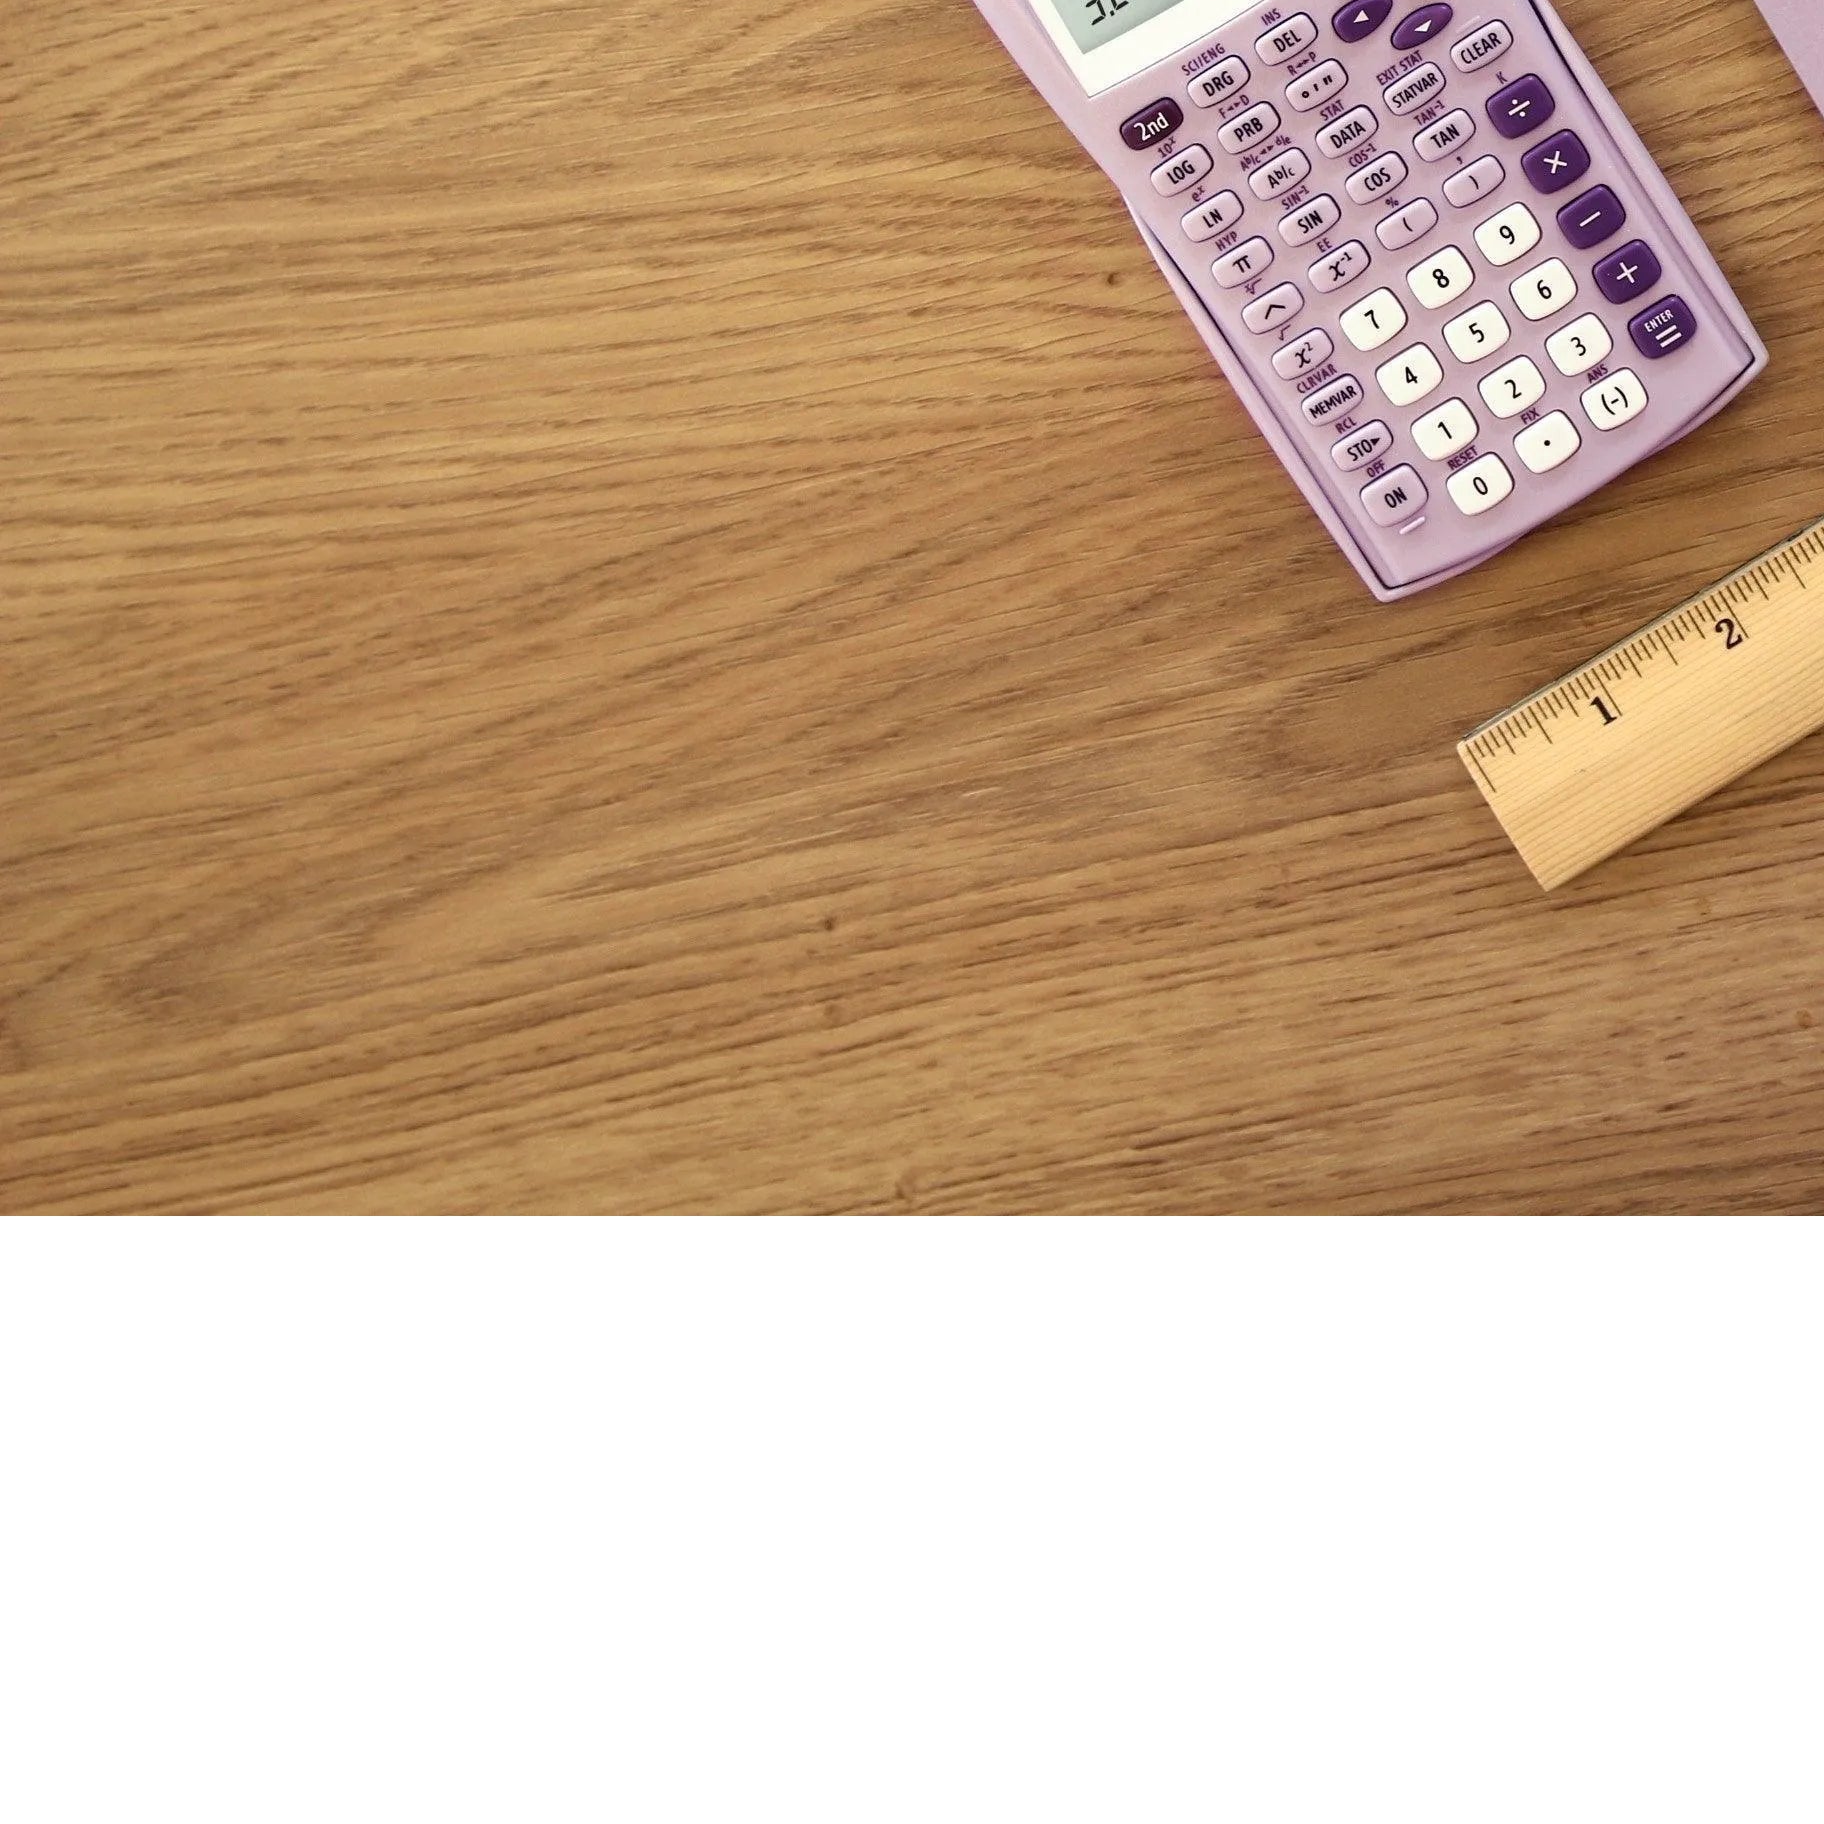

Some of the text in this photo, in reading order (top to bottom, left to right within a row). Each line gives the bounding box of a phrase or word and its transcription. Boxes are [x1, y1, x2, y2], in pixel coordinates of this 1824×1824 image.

[1261, 8, 1281, 26] INS
[1273, 29, 1302, 53] DEL
[1460, 32, 1502, 64] CLEAR
[1376, 50, 1424, 86] EXIT STAT
[1496, 71, 1508, 84] K
[1202, 71, 1235, 97] DRG
[1391, 72, 1438, 110] STATVAR
[1320, 99, 1345, 121] STAT
[1133, 112, 1169, 141] 2nd
[1233, 117, 1263, 142] PRB
[1329, 120, 1366, 150] DATA
[1430, 123, 1461, 150] TAN
[1166, 160, 1196, 185] LOG
[1363, 167, 1391, 192] COS
[1385, 197, 1399, 208] %
[1202, 208, 1224, 229] LN
[1297, 210, 1324, 234] SIN
[1215, 231, 1238, 252] HYP
[1316, 237, 1333, 253] EE
[1499, 225, 1515, 245] 9
[1432, 268, 1450, 288] 8
[1537, 279, 1552, 300] 6
[1363, 309, 1380, 330] 7
[1644, 309, 1674, 333] ENTER
[1468, 322, 1485, 344] 5
[1570, 336, 1587, 357] 3
[1296, 363, 1338, 394] CLRVAR
[1404, 366, 1419, 385] 4
[1586, 363, 1609, 384] ANS
[1504, 378, 1522, 399] 2
[1309, 385, 1358, 419] MEMVAR
[1335, 416, 1358, 434] RCL
[1520, 407, 1540, 425] FIX
[1437, 421, 1453, 440] 1
[1366, 459, 1386, 478] OFF
[1447, 445, 1479, 471] RESET
[1472, 476, 1488, 496] 0
[1384, 487, 1408, 509] ON
[1714, 617, 1743, 650] 2
[1588, 696, 1618, 725] 1
